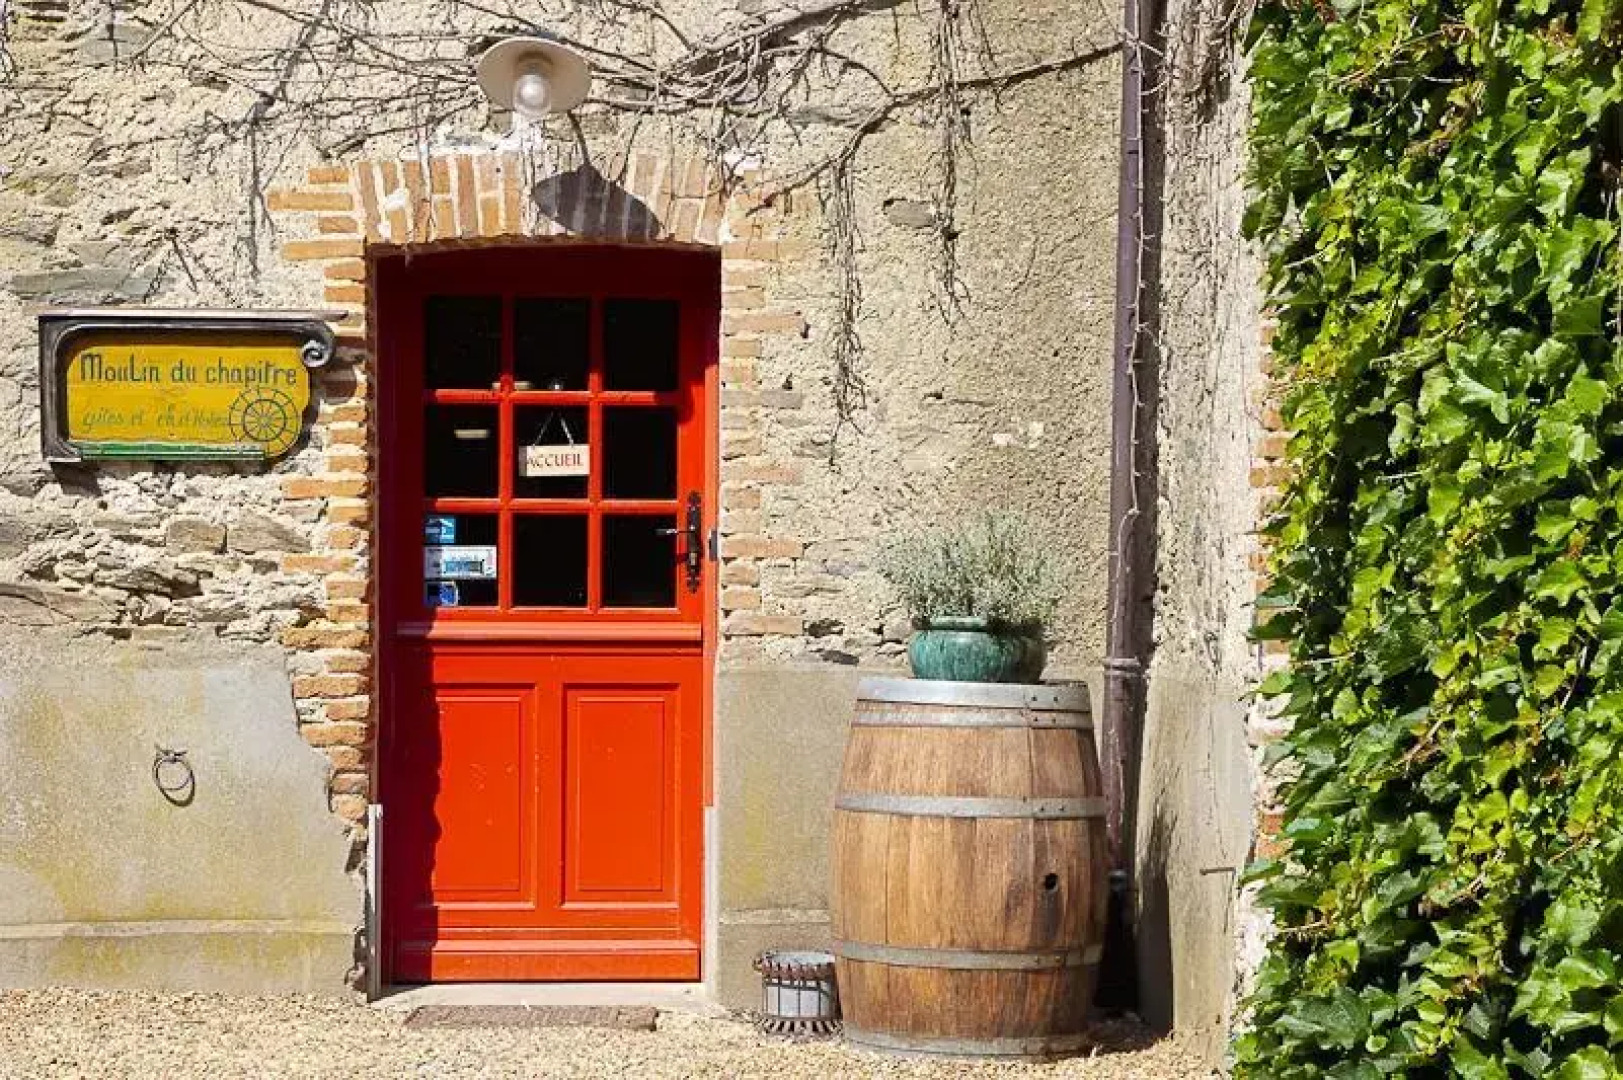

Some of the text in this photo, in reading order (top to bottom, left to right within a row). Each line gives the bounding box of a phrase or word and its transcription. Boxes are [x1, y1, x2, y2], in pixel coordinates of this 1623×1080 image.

[171, 359, 197, 384] du
[206, 356, 298, 388] chapitre
[525, 453, 585, 468] ACCUEIL
